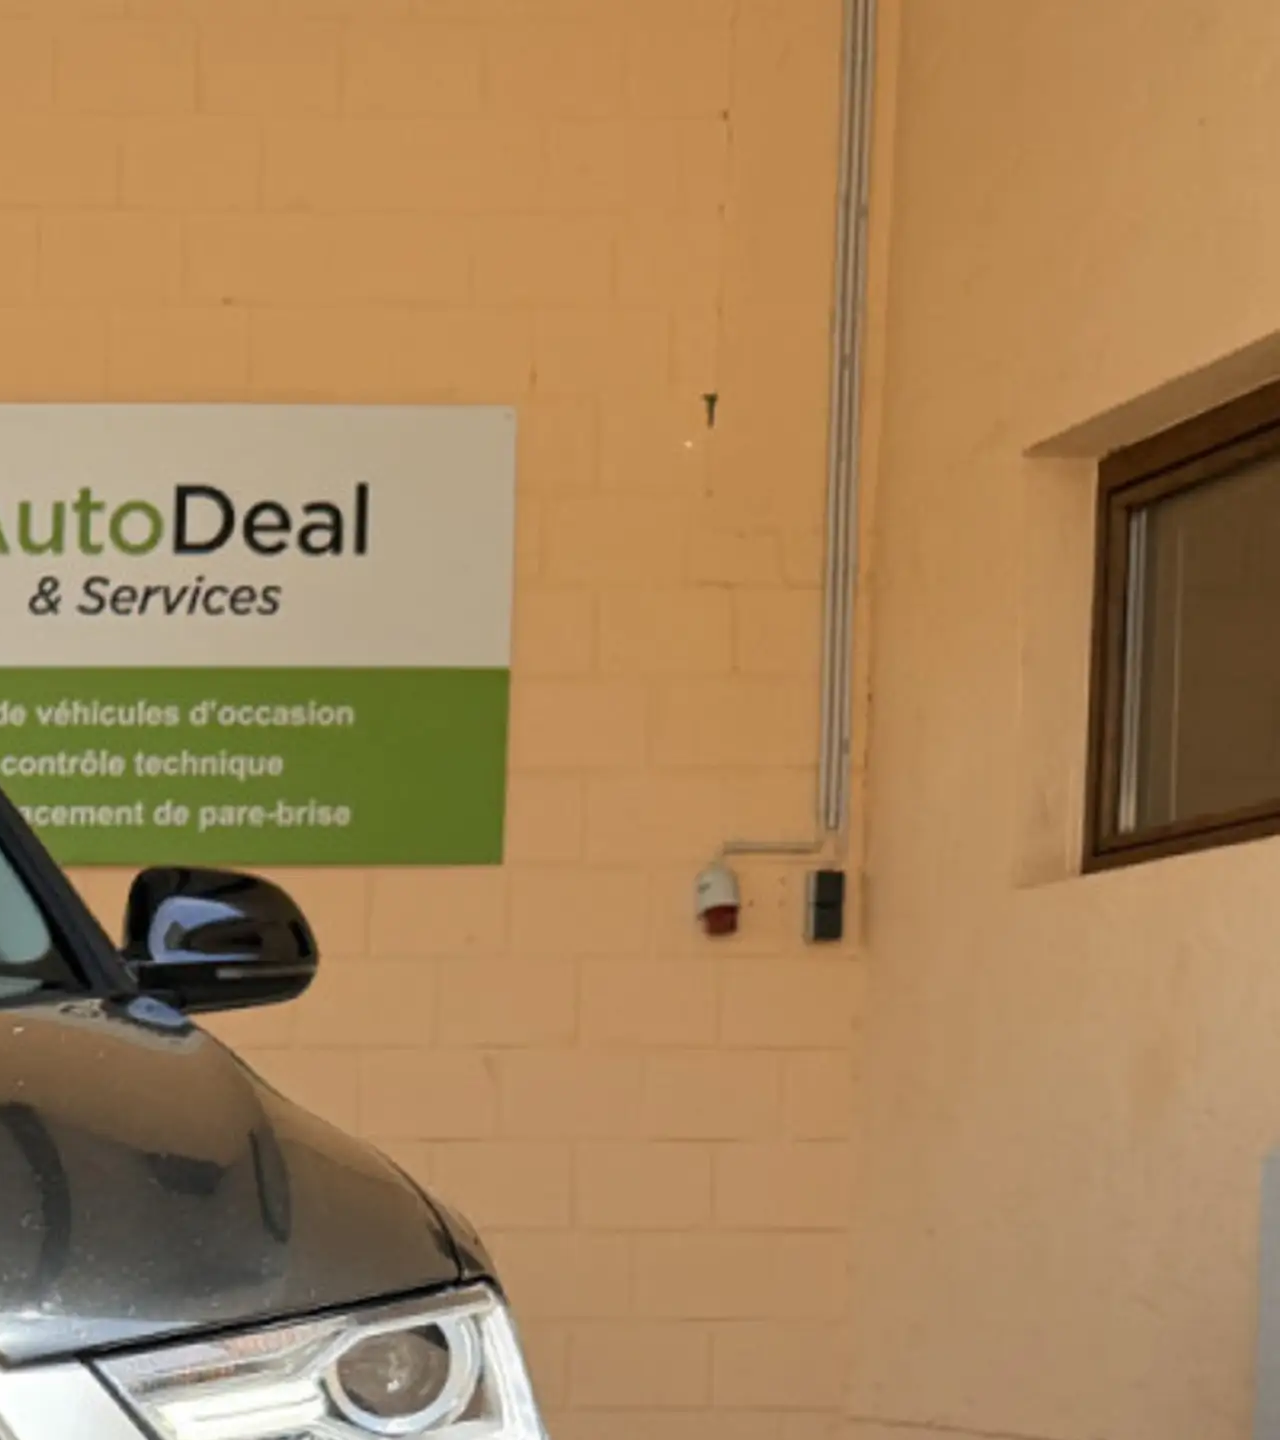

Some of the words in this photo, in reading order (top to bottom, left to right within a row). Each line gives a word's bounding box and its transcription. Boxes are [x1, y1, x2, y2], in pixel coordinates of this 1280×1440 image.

[29, 576, 60, 615] &
[77, 575, 282, 615] Services
[36, 700, 179, 726] véhicules
[189, 700, 355, 726] d'occasion
[0, 750, 125, 775] contrôle
[133, 750, 284, 781] technique
[19, 803, 143, 826] acement
[153, 799, 189, 826] de
[197, 799, 351, 832] pare-brise
